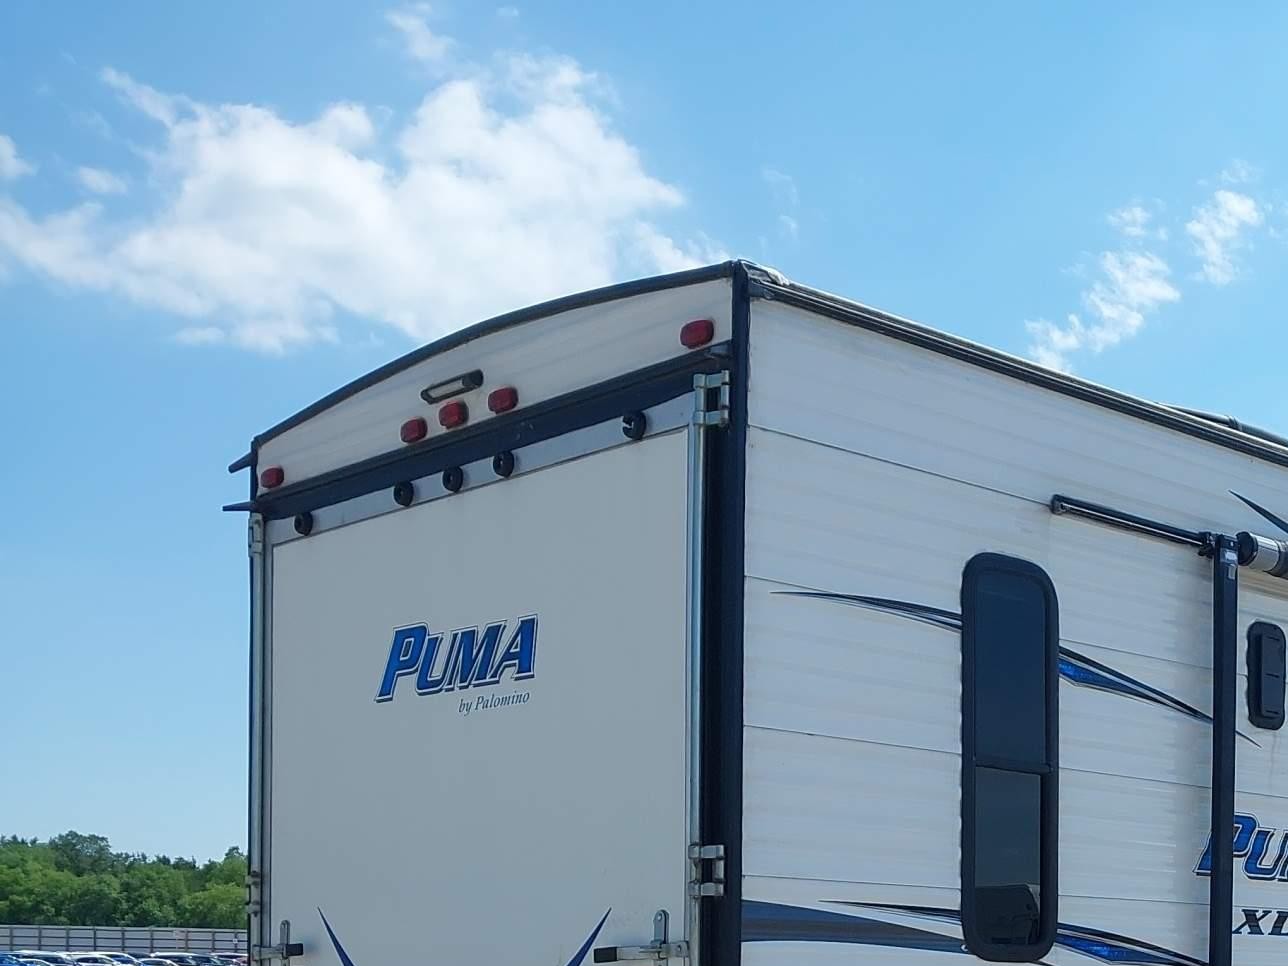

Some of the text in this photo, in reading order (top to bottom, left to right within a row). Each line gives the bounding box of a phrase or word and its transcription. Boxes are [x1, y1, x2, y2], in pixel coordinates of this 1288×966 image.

[374, 613, 539, 703] PUMA
[458, 691, 530, 717] by Palomino
